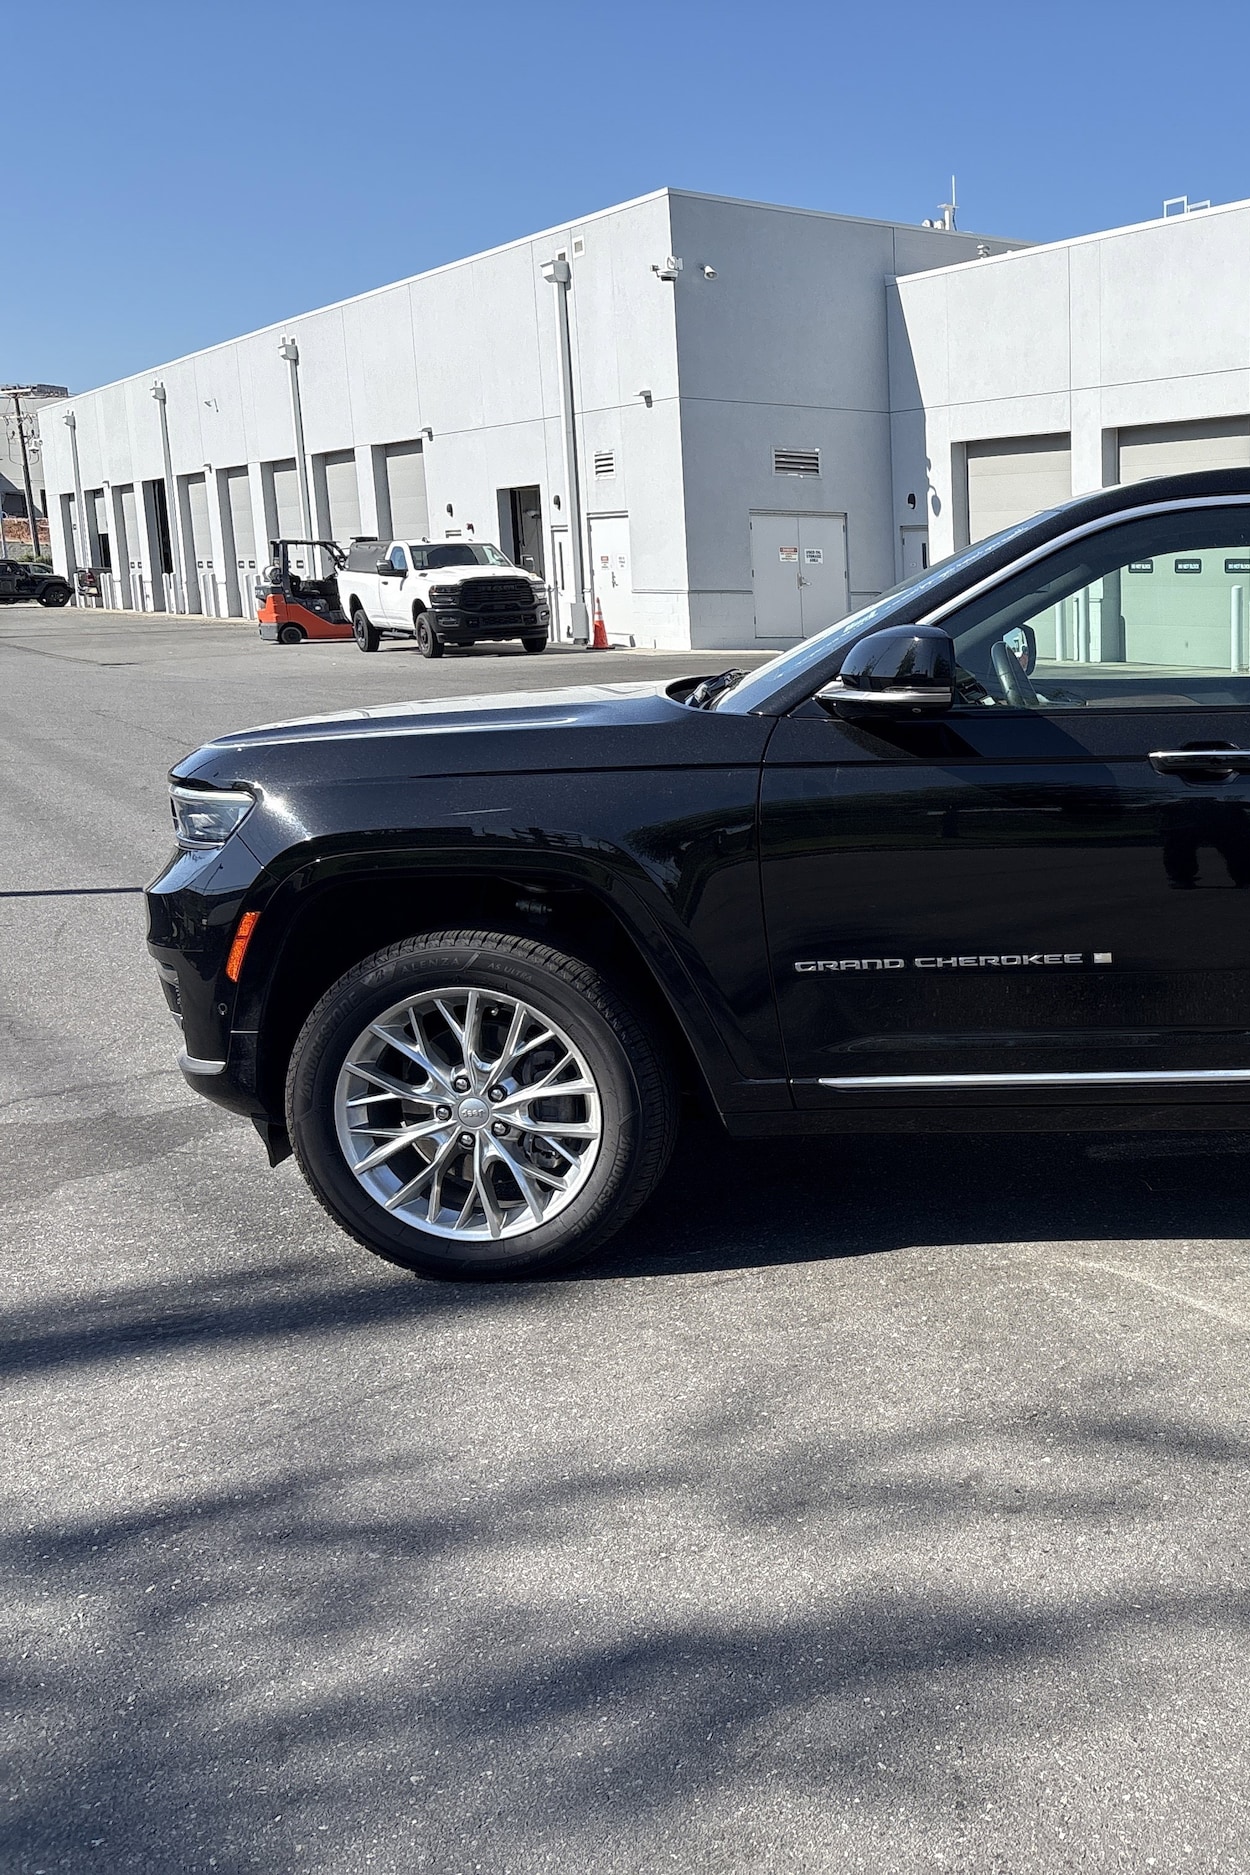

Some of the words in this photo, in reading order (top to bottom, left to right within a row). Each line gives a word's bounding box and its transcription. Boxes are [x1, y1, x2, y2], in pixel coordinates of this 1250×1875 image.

[401, 957, 460, 974] ALENZA
[487, 962, 500, 970] AS
[504, 965, 534, 982] ULTRA
[794, 957, 905, 973] GRAND
[914, 952, 1084, 969] CHEROKEE
[299, 991, 360, 1101] BRIDGESTONE
[571, 1134, 634, 1239] BRIDGESTONE
